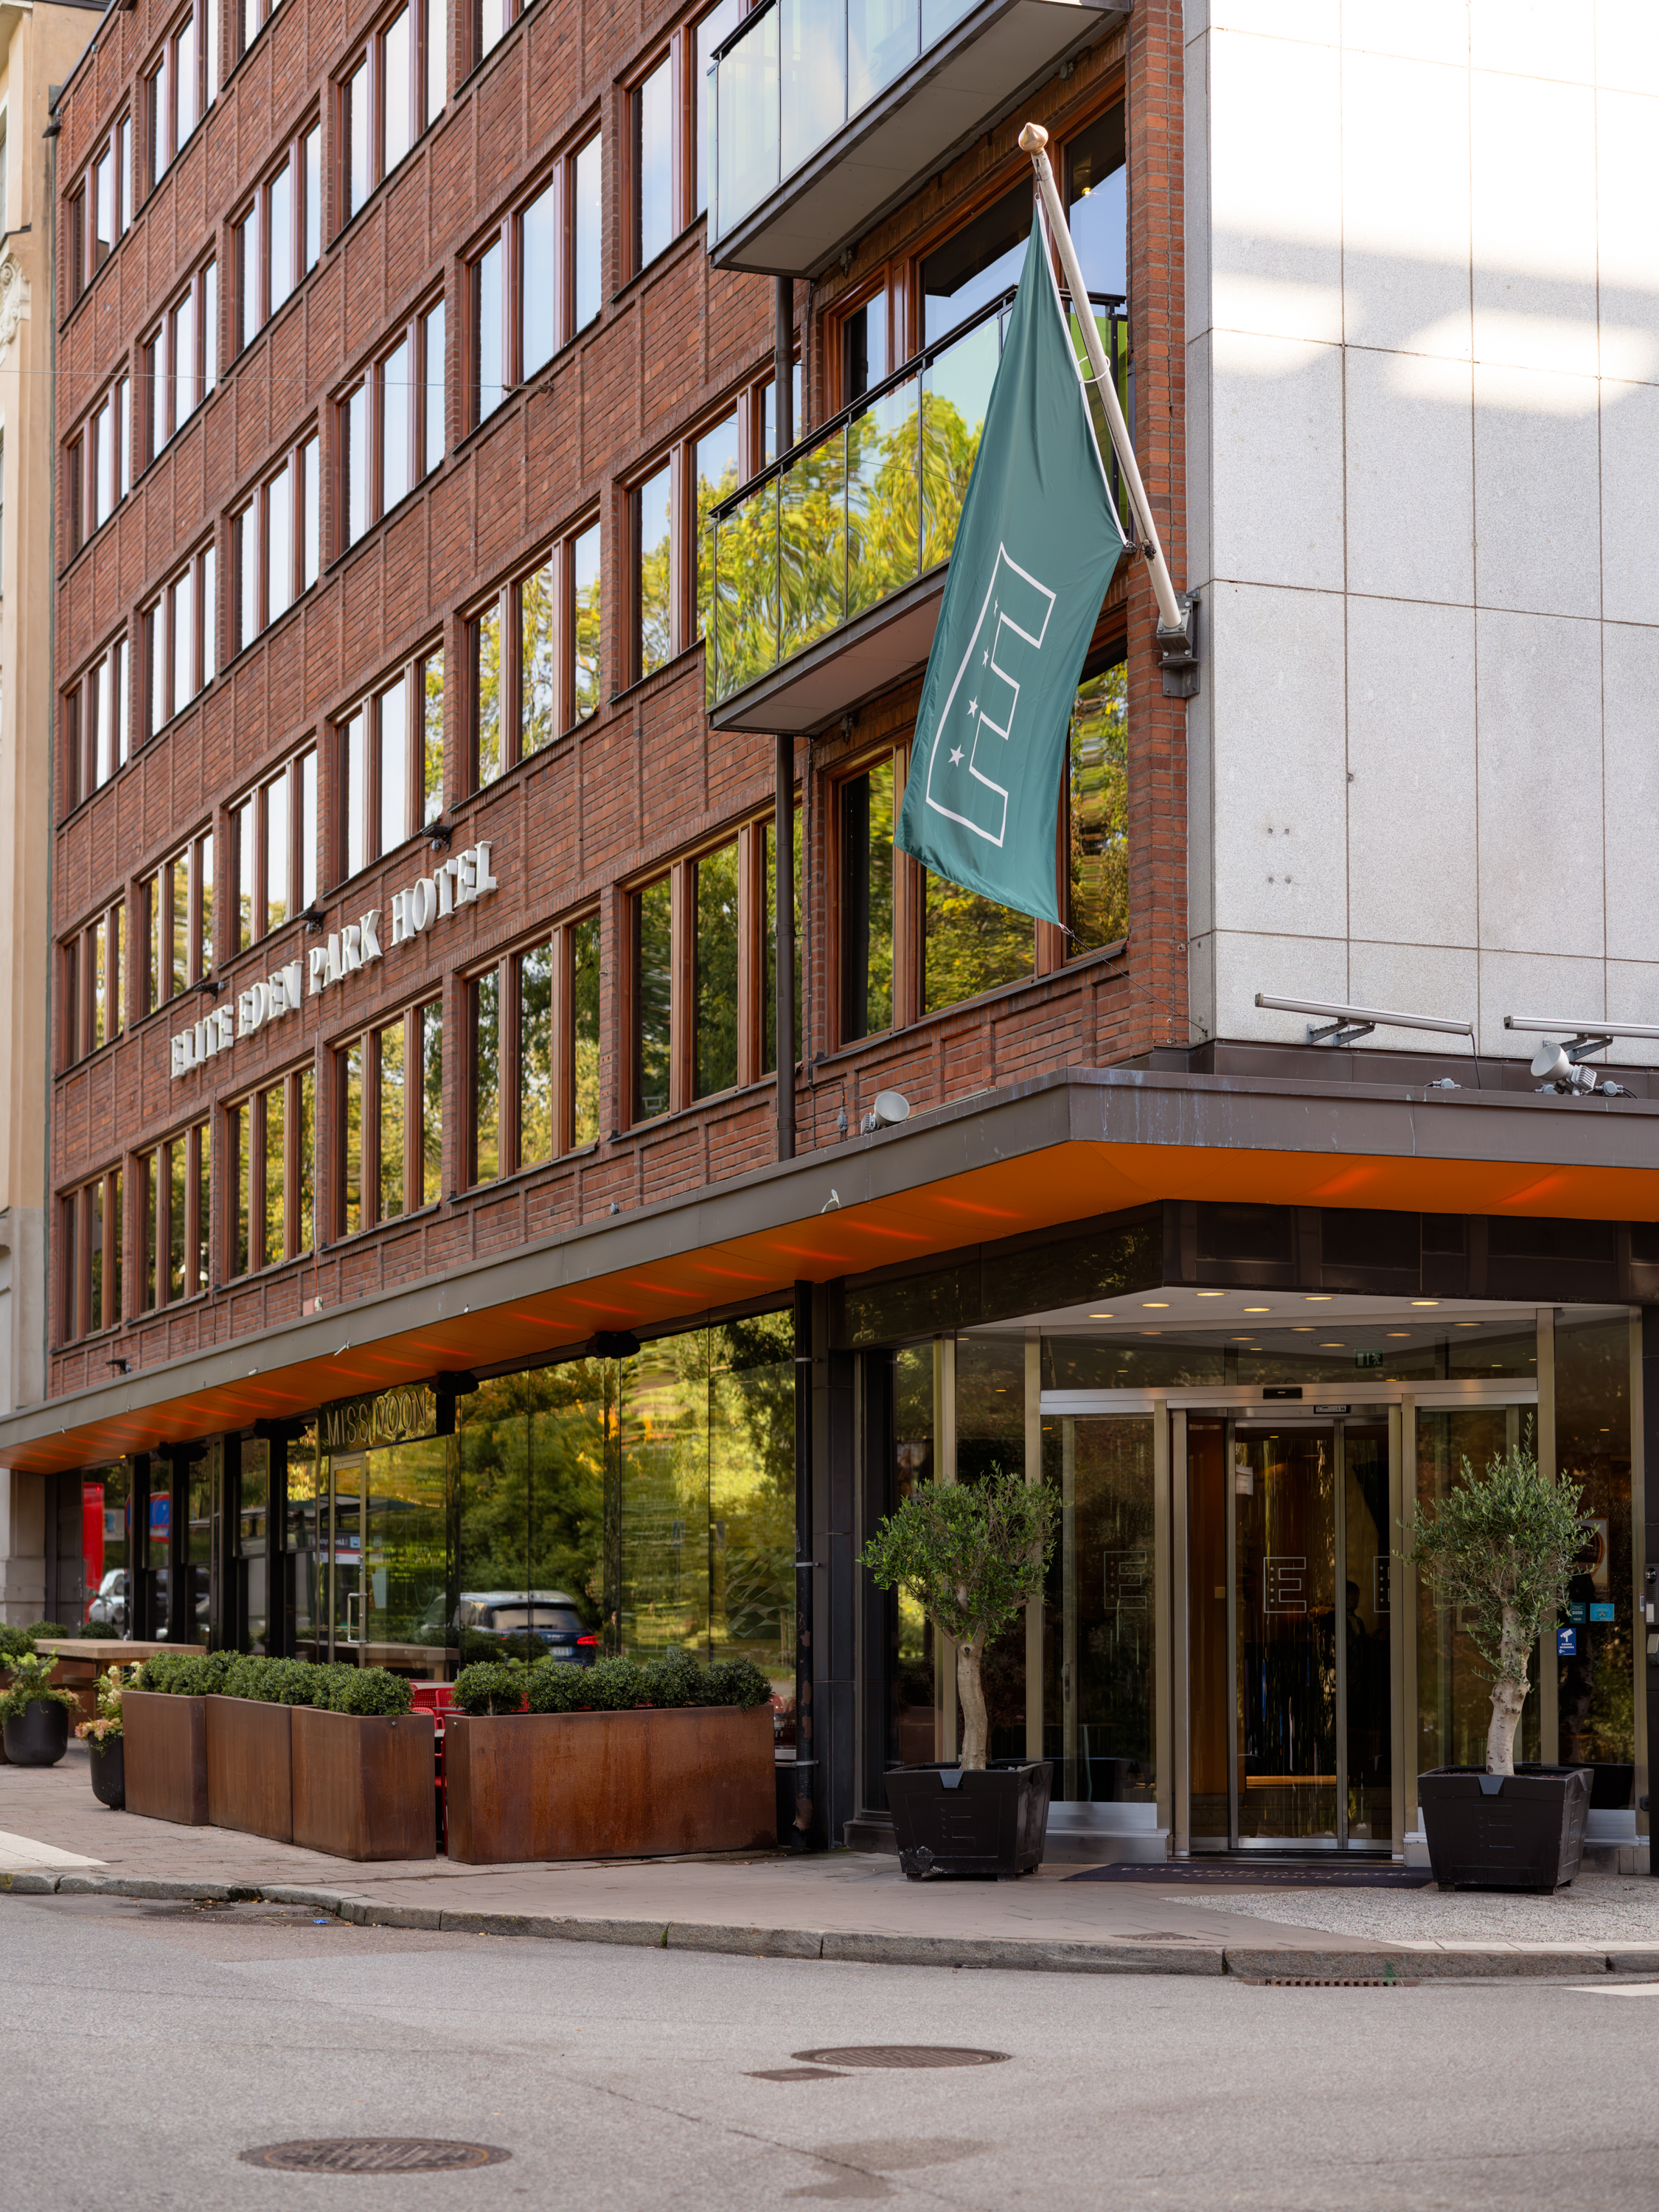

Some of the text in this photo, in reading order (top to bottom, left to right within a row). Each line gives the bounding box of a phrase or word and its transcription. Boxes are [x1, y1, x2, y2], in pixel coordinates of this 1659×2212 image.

[170, 841, 498, 1079] ELITE EDEN PARK HOTEL
[327, 1389, 426, 1447] MISS VOON
